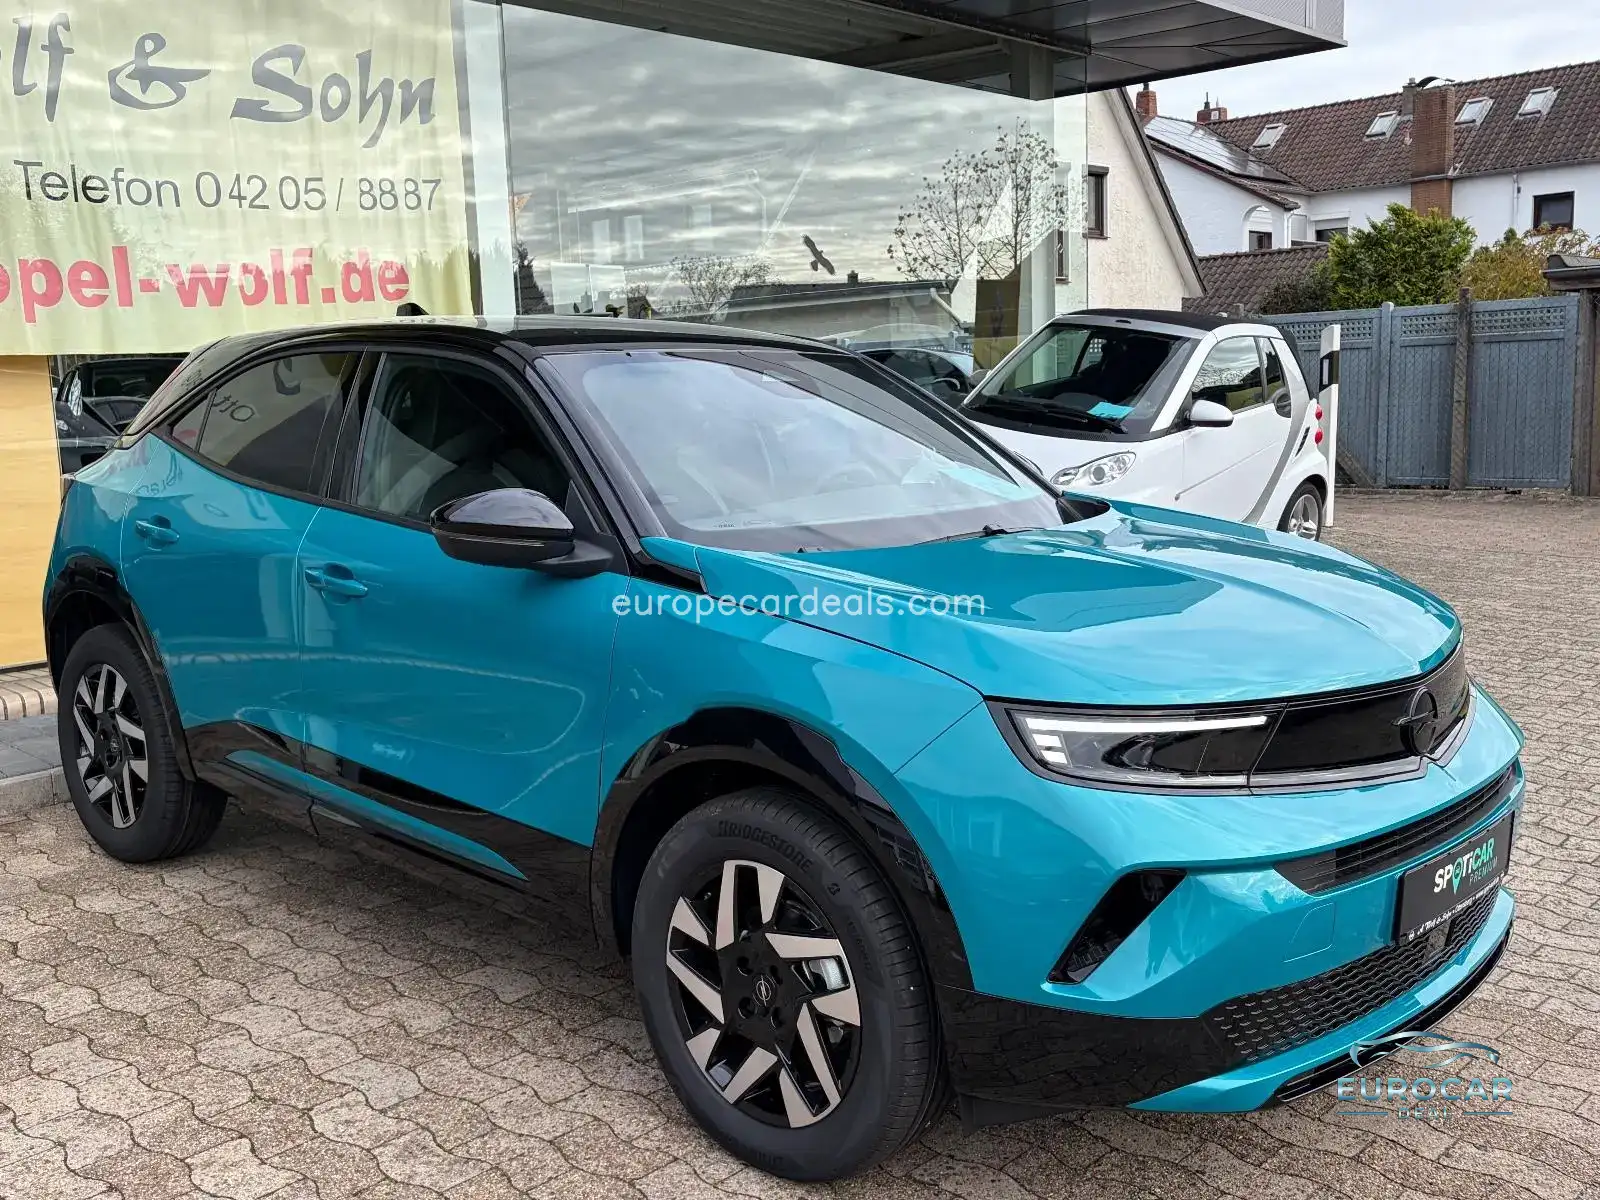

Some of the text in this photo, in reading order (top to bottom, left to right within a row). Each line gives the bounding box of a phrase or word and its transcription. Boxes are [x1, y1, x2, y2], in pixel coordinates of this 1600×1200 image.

[0, 12, 436, 149] lf & Sohn
[13, 159, 181, 208] Telefon
[0, 246, 411, 325] pel-wolf.de
[717, 820, 813, 875] BRIDGESTONE
